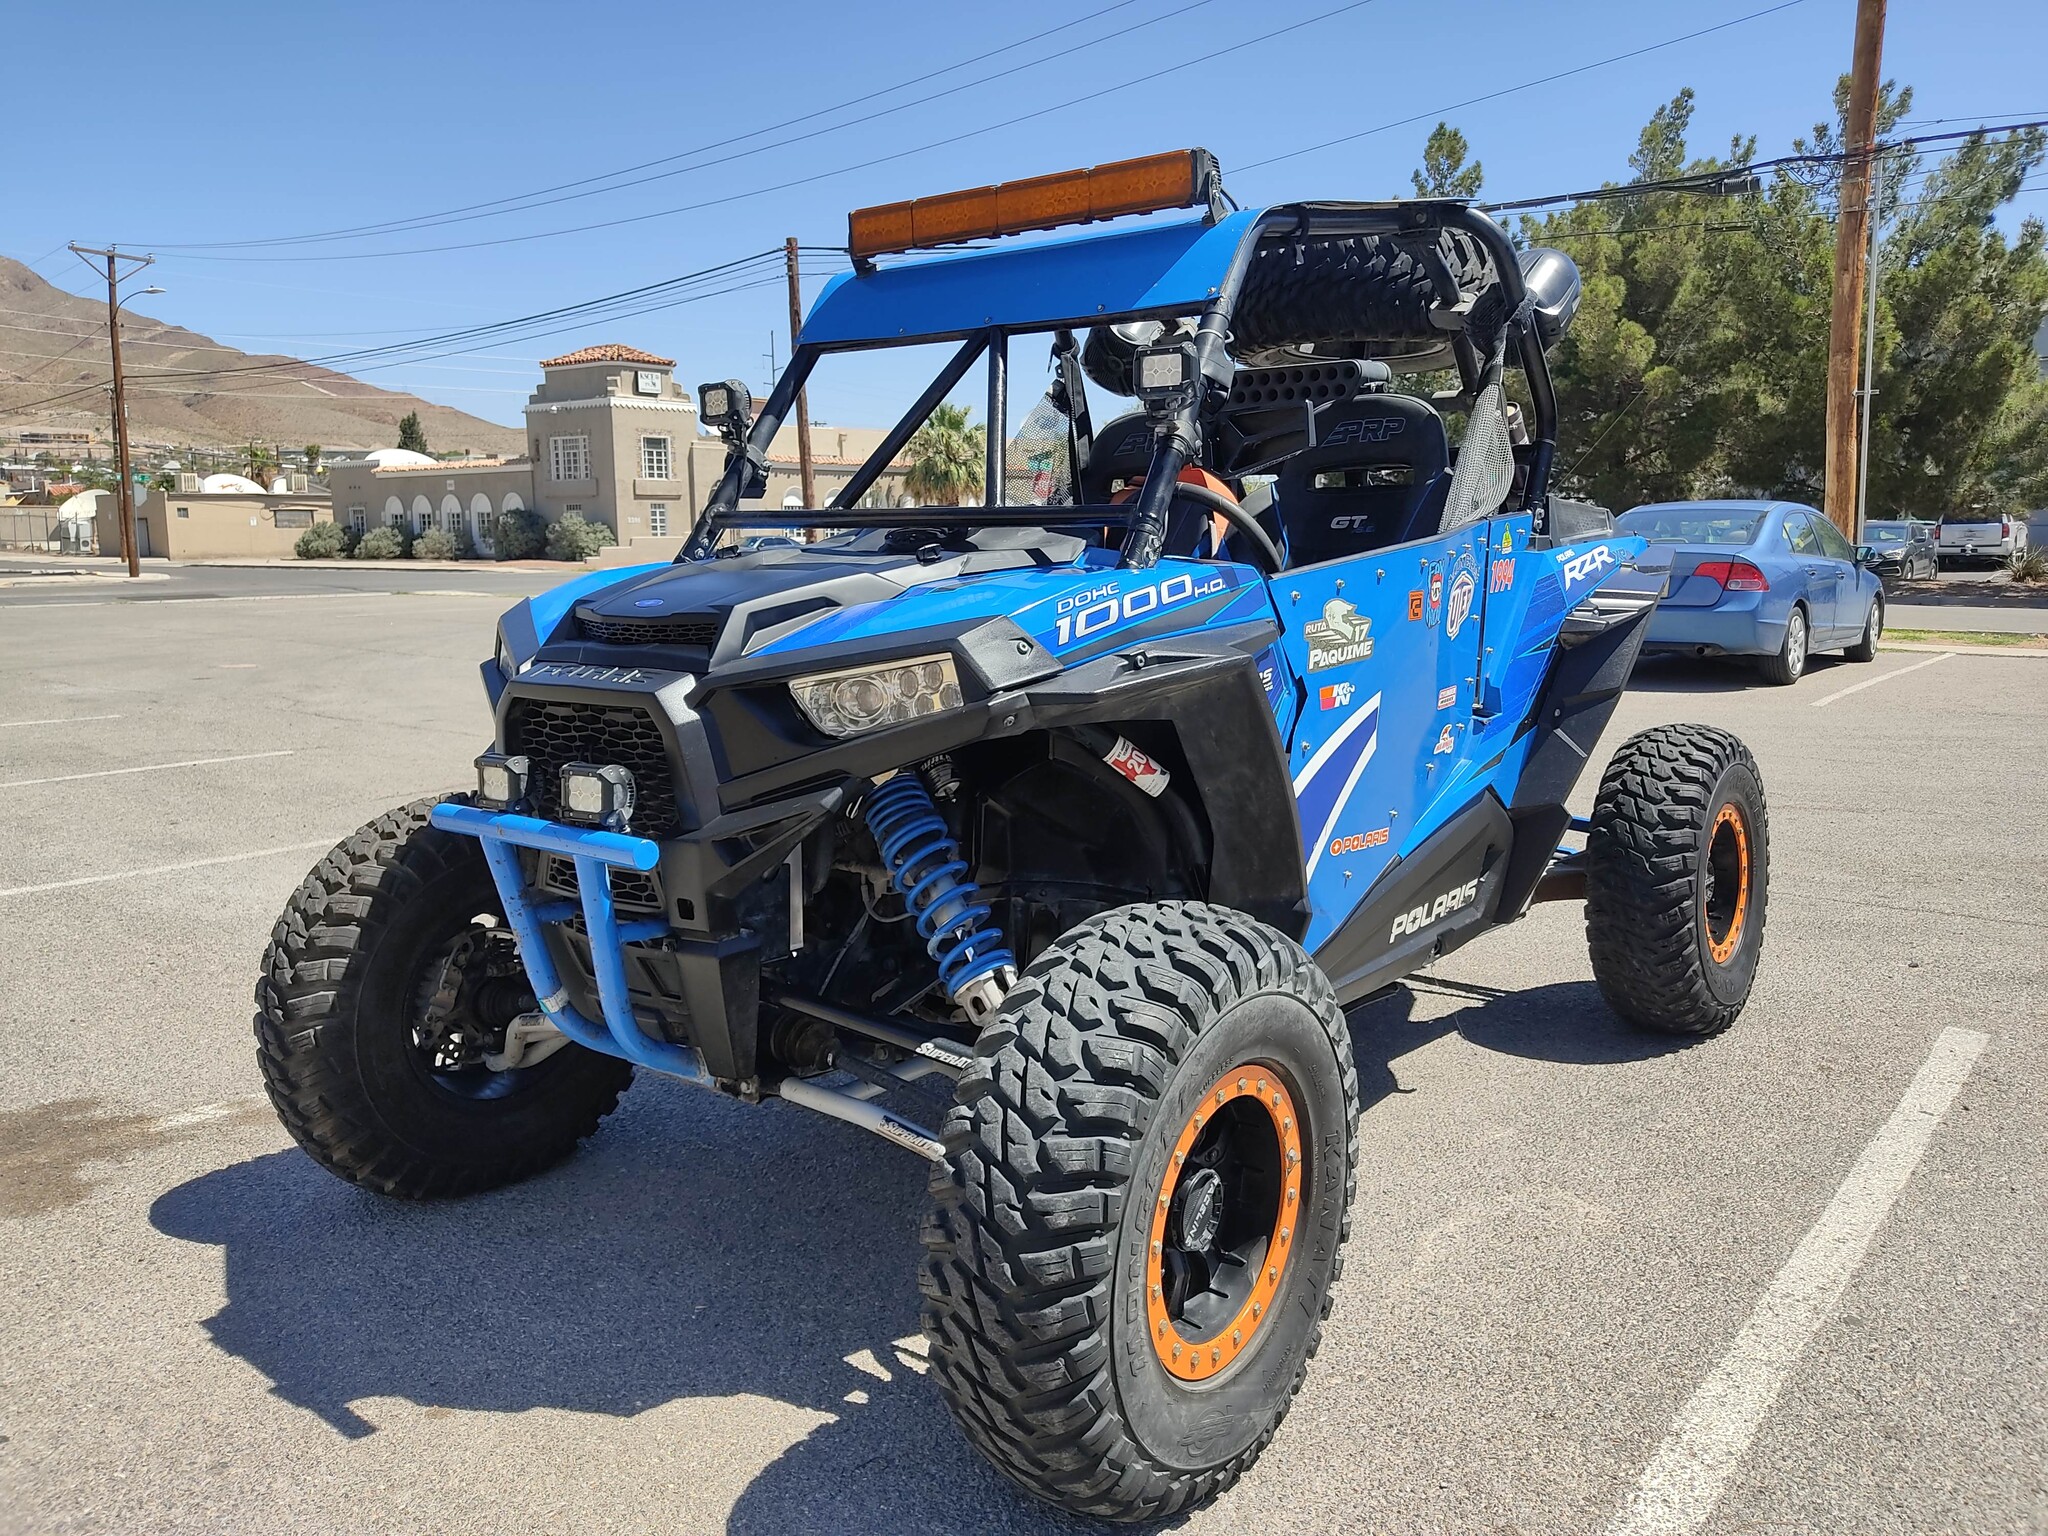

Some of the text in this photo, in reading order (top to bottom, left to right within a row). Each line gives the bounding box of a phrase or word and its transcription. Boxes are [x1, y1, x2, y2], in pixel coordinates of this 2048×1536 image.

[1321, 417, 1406, 446] PRP
[1331, 515, 1368, 529] GT
[1490, 558, 1516, 593] 1994
[1563, 545, 1616, 592] RZR
[1056, 574, 1192, 646] 1000
[1057, 581, 1120, 614] DOHC
[1305, 622, 1370, 642] RUTA 17
[1309, 640, 1373, 670] PAQUIME
[1342, 828, 1390, 854] POLARIS
[1389, 878, 1479, 944] POLARIS
[915, 1042, 974, 1068] SUPERAT
